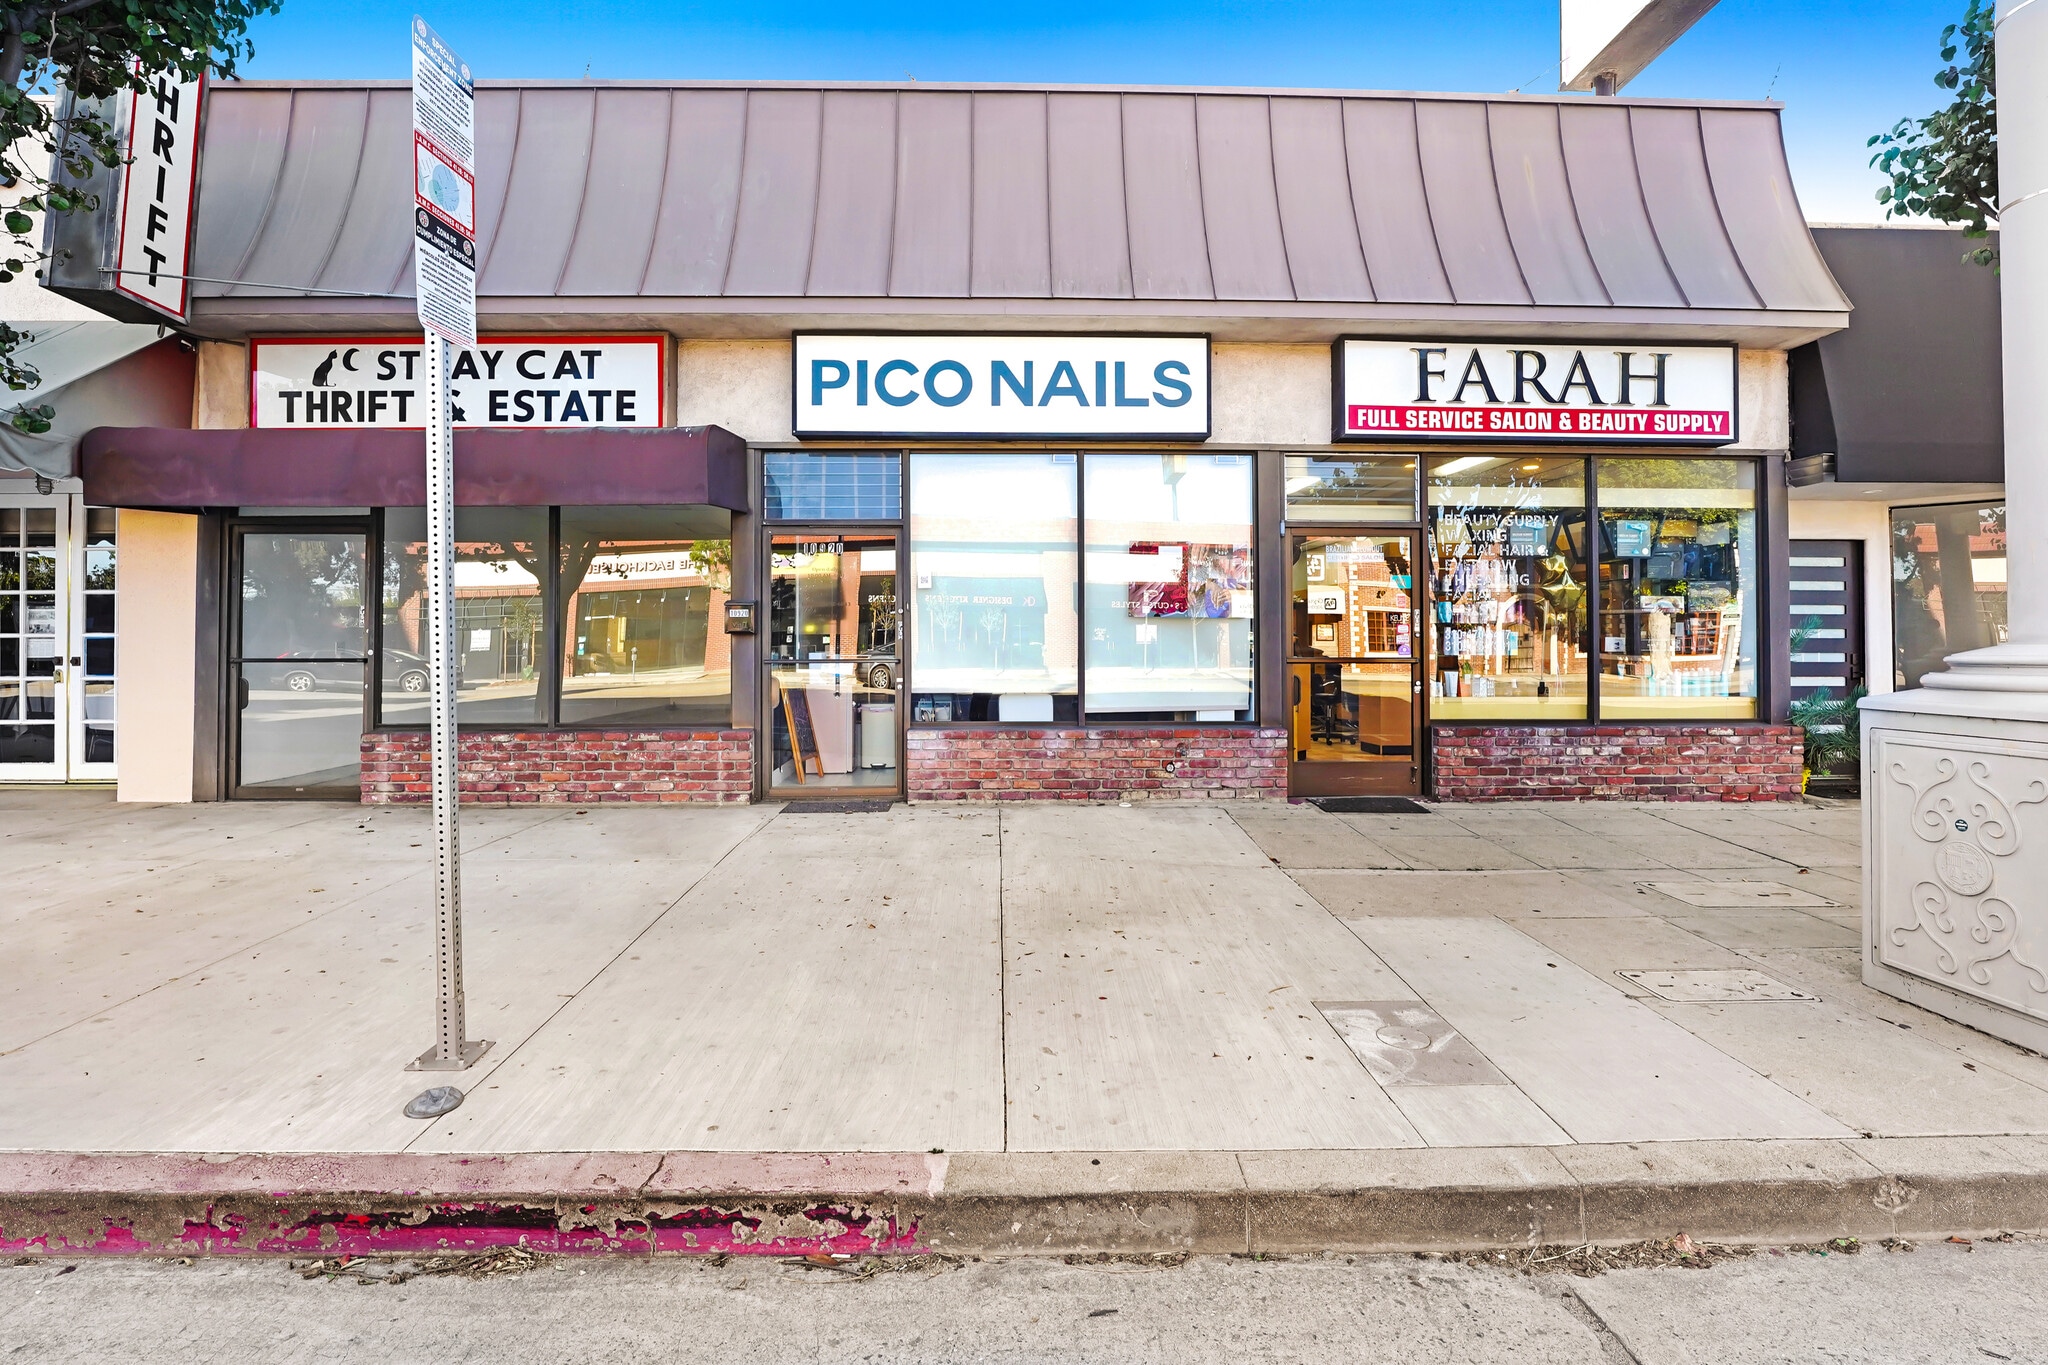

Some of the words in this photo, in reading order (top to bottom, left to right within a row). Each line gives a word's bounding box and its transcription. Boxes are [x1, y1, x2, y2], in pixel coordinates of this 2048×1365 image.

[414, 31, 456, 81] ENFORCEMENT
[457, 74, 472, 96] ZONE
[431, 36, 456, 68] SPECIAL
[416, 224, 452, 254] CUMPLIMIENTO
[453, 247, 474, 268] ESPECIAL
[436, 225, 449, 241] ZONA
[450, 234, 456, 246] DE
[376, 350, 509, 381] STAY
[515, 350, 603, 380] CAT
[1410, 347, 1673, 407] FARAH
[811, 359, 973, 407] PICO
[990, 360, 1193, 408] NAILS
[278, 389, 415, 424] THRIFT
[488, 389, 637, 422] ESTATE
[1356, 407, 1400, 428] FULL
[1405, 409, 1484, 430] SERVICE
[1489, 410, 1552, 431] SALON
[1558, 412, 1573, 431] &
[1578, 412, 1651, 433] BEAUTY
[1653, 414, 1724, 433] SUPPLY
[1444, 514, 1502, 527] BEAUTY
[1506, 515, 1560, 528] SUPPLY
[1444, 529, 1508, 542] WAXING
[803, 543, 844, 555] 10920
[1499, 544, 1534, 557] HAIR
